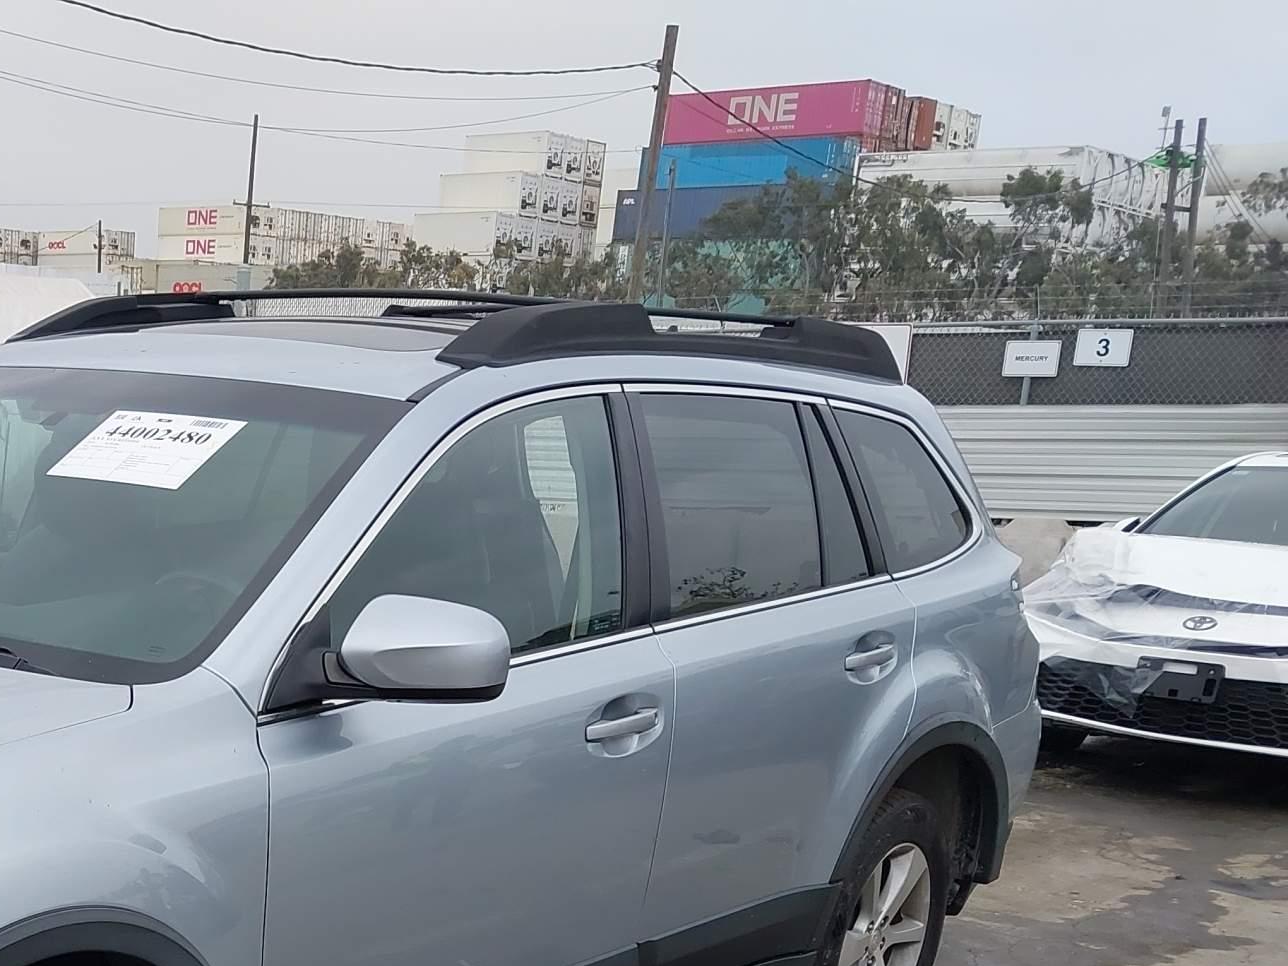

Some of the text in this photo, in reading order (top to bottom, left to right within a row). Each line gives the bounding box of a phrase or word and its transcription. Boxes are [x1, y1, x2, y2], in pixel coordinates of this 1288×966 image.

[727, 93, 799, 125] ONE
[187, 209, 218, 226] ONE
[185, 239, 216, 255] ONE
[1096, 338, 1110, 357] 3
[105, 425, 212, 446] 44002480
